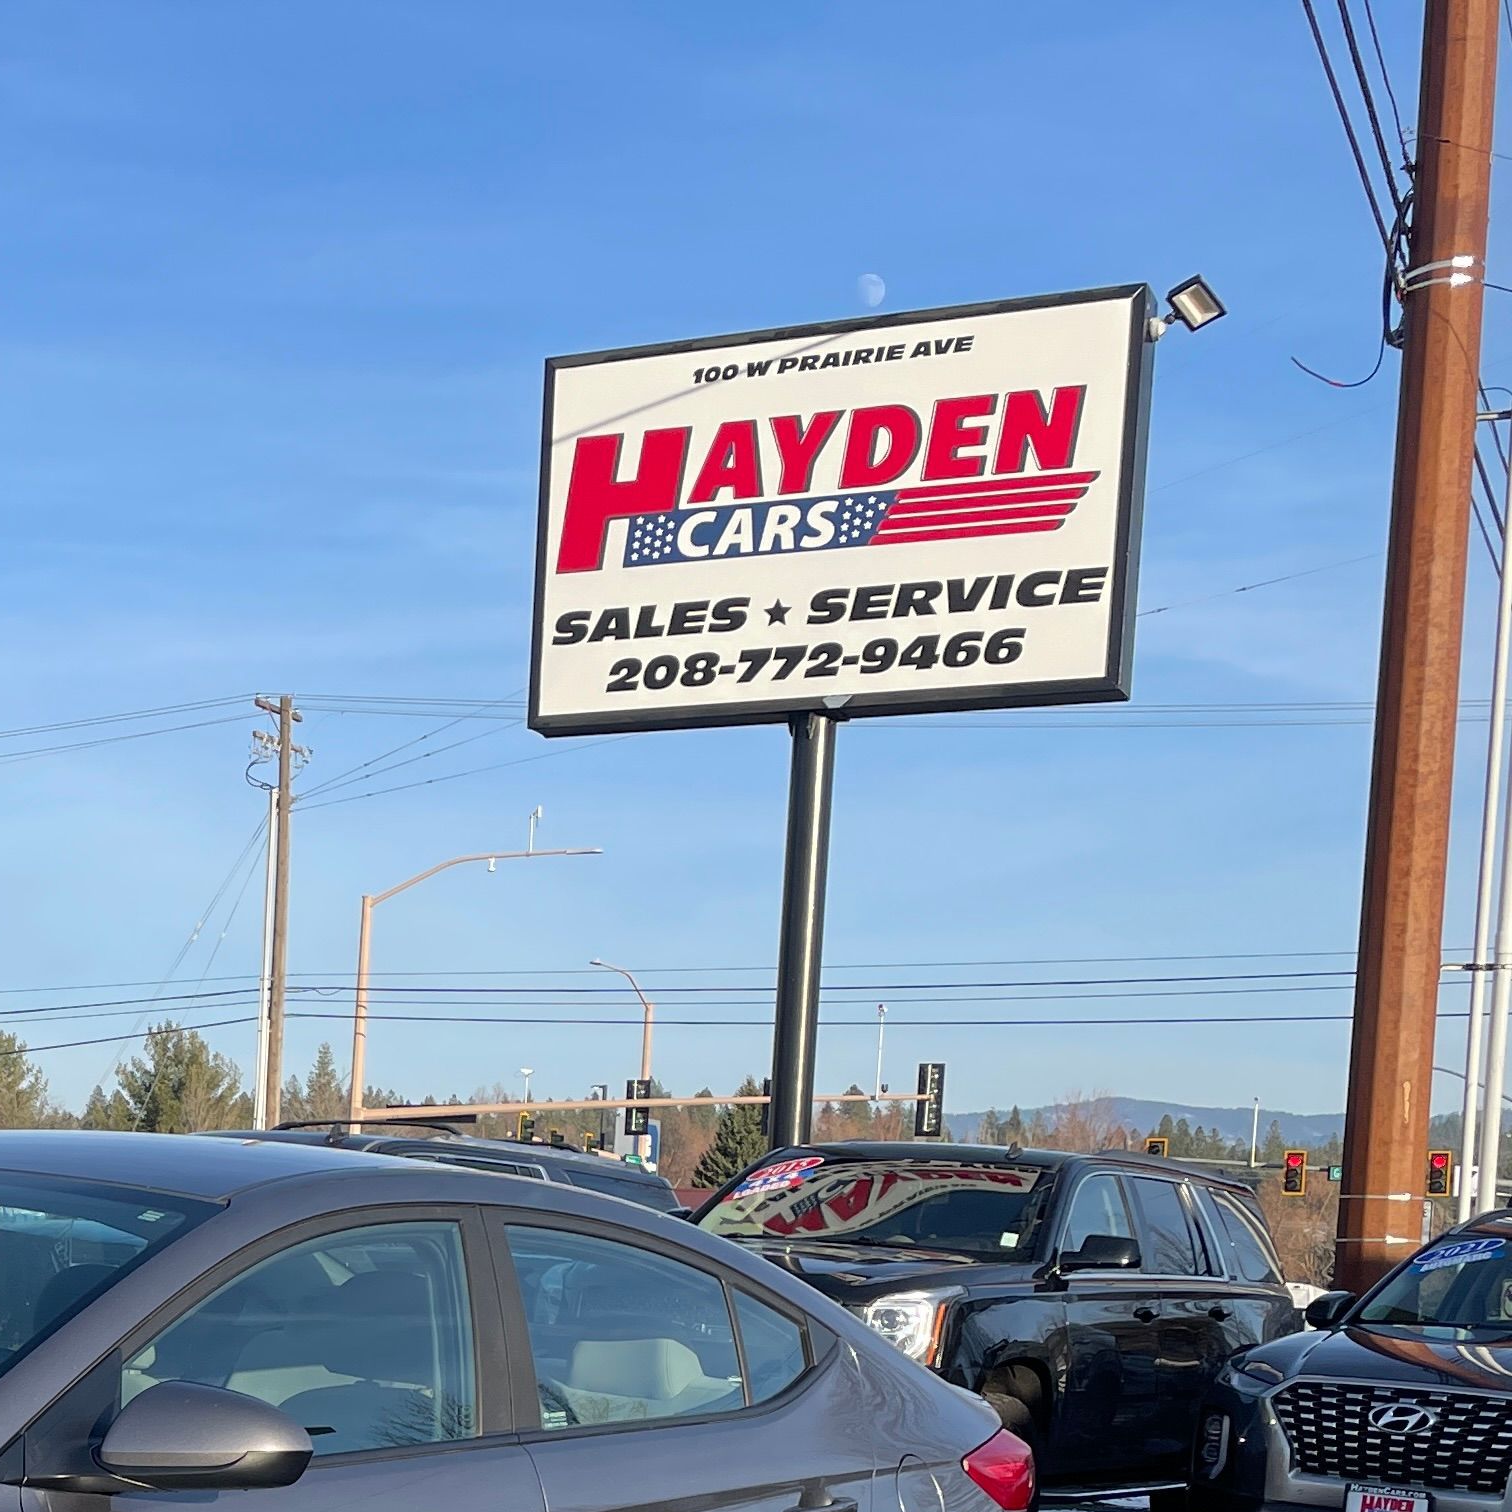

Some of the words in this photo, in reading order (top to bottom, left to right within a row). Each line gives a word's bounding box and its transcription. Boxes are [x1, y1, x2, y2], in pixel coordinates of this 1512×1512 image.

[692, 363, 739, 384] 100
[746, 360, 773, 378] W
[777, 343, 907, 375] PRAIRIE
[909, 335, 975, 359] AVE
[555, 384, 1088, 575] HAYDEN
[676, 499, 841, 560] CARS
[552, 596, 751, 646] SALES
[805, 566, 1110, 626] SERVICE
[604, 627, 1027, 693] 208-772-9466
